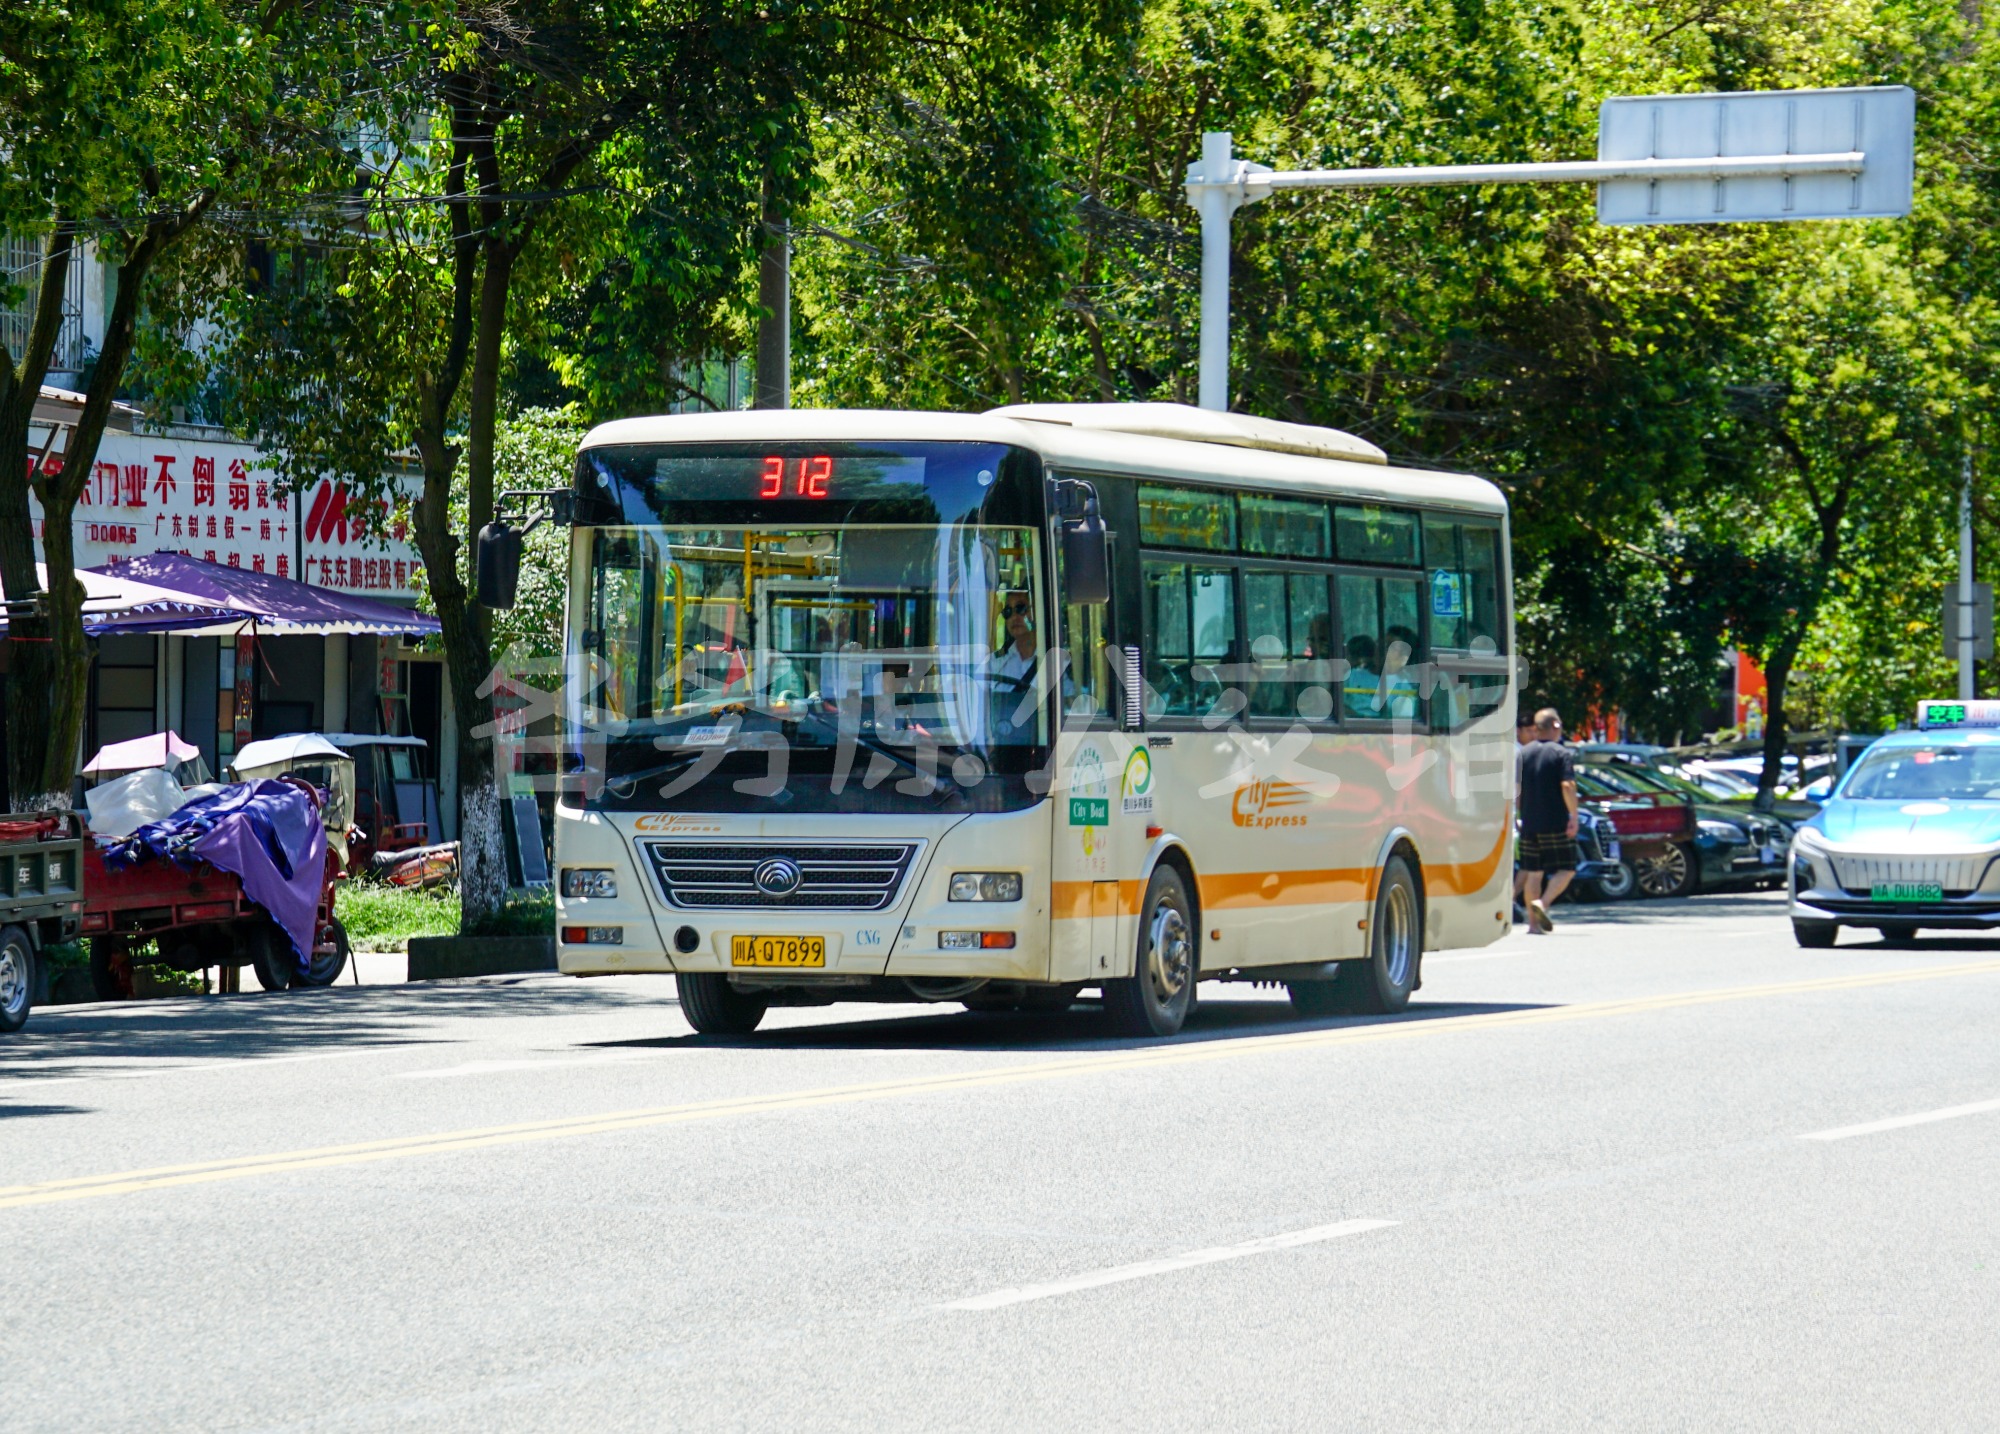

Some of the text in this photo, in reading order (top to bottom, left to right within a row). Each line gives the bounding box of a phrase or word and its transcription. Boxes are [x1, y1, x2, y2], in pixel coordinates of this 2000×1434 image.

[760, 456, 832, 499] 312
[155, 512, 288, 542] 广东制造假一赔十
[1928, 705, 1965, 723] 空车
[1232, 775, 1271, 827] City
[1073, 802, 1087, 821] City
[635, 812, 680, 831] City
[648, 824, 721, 833] Express
[1245, 813, 1307, 830] Express
[856, 929, 880, 946] CNG
